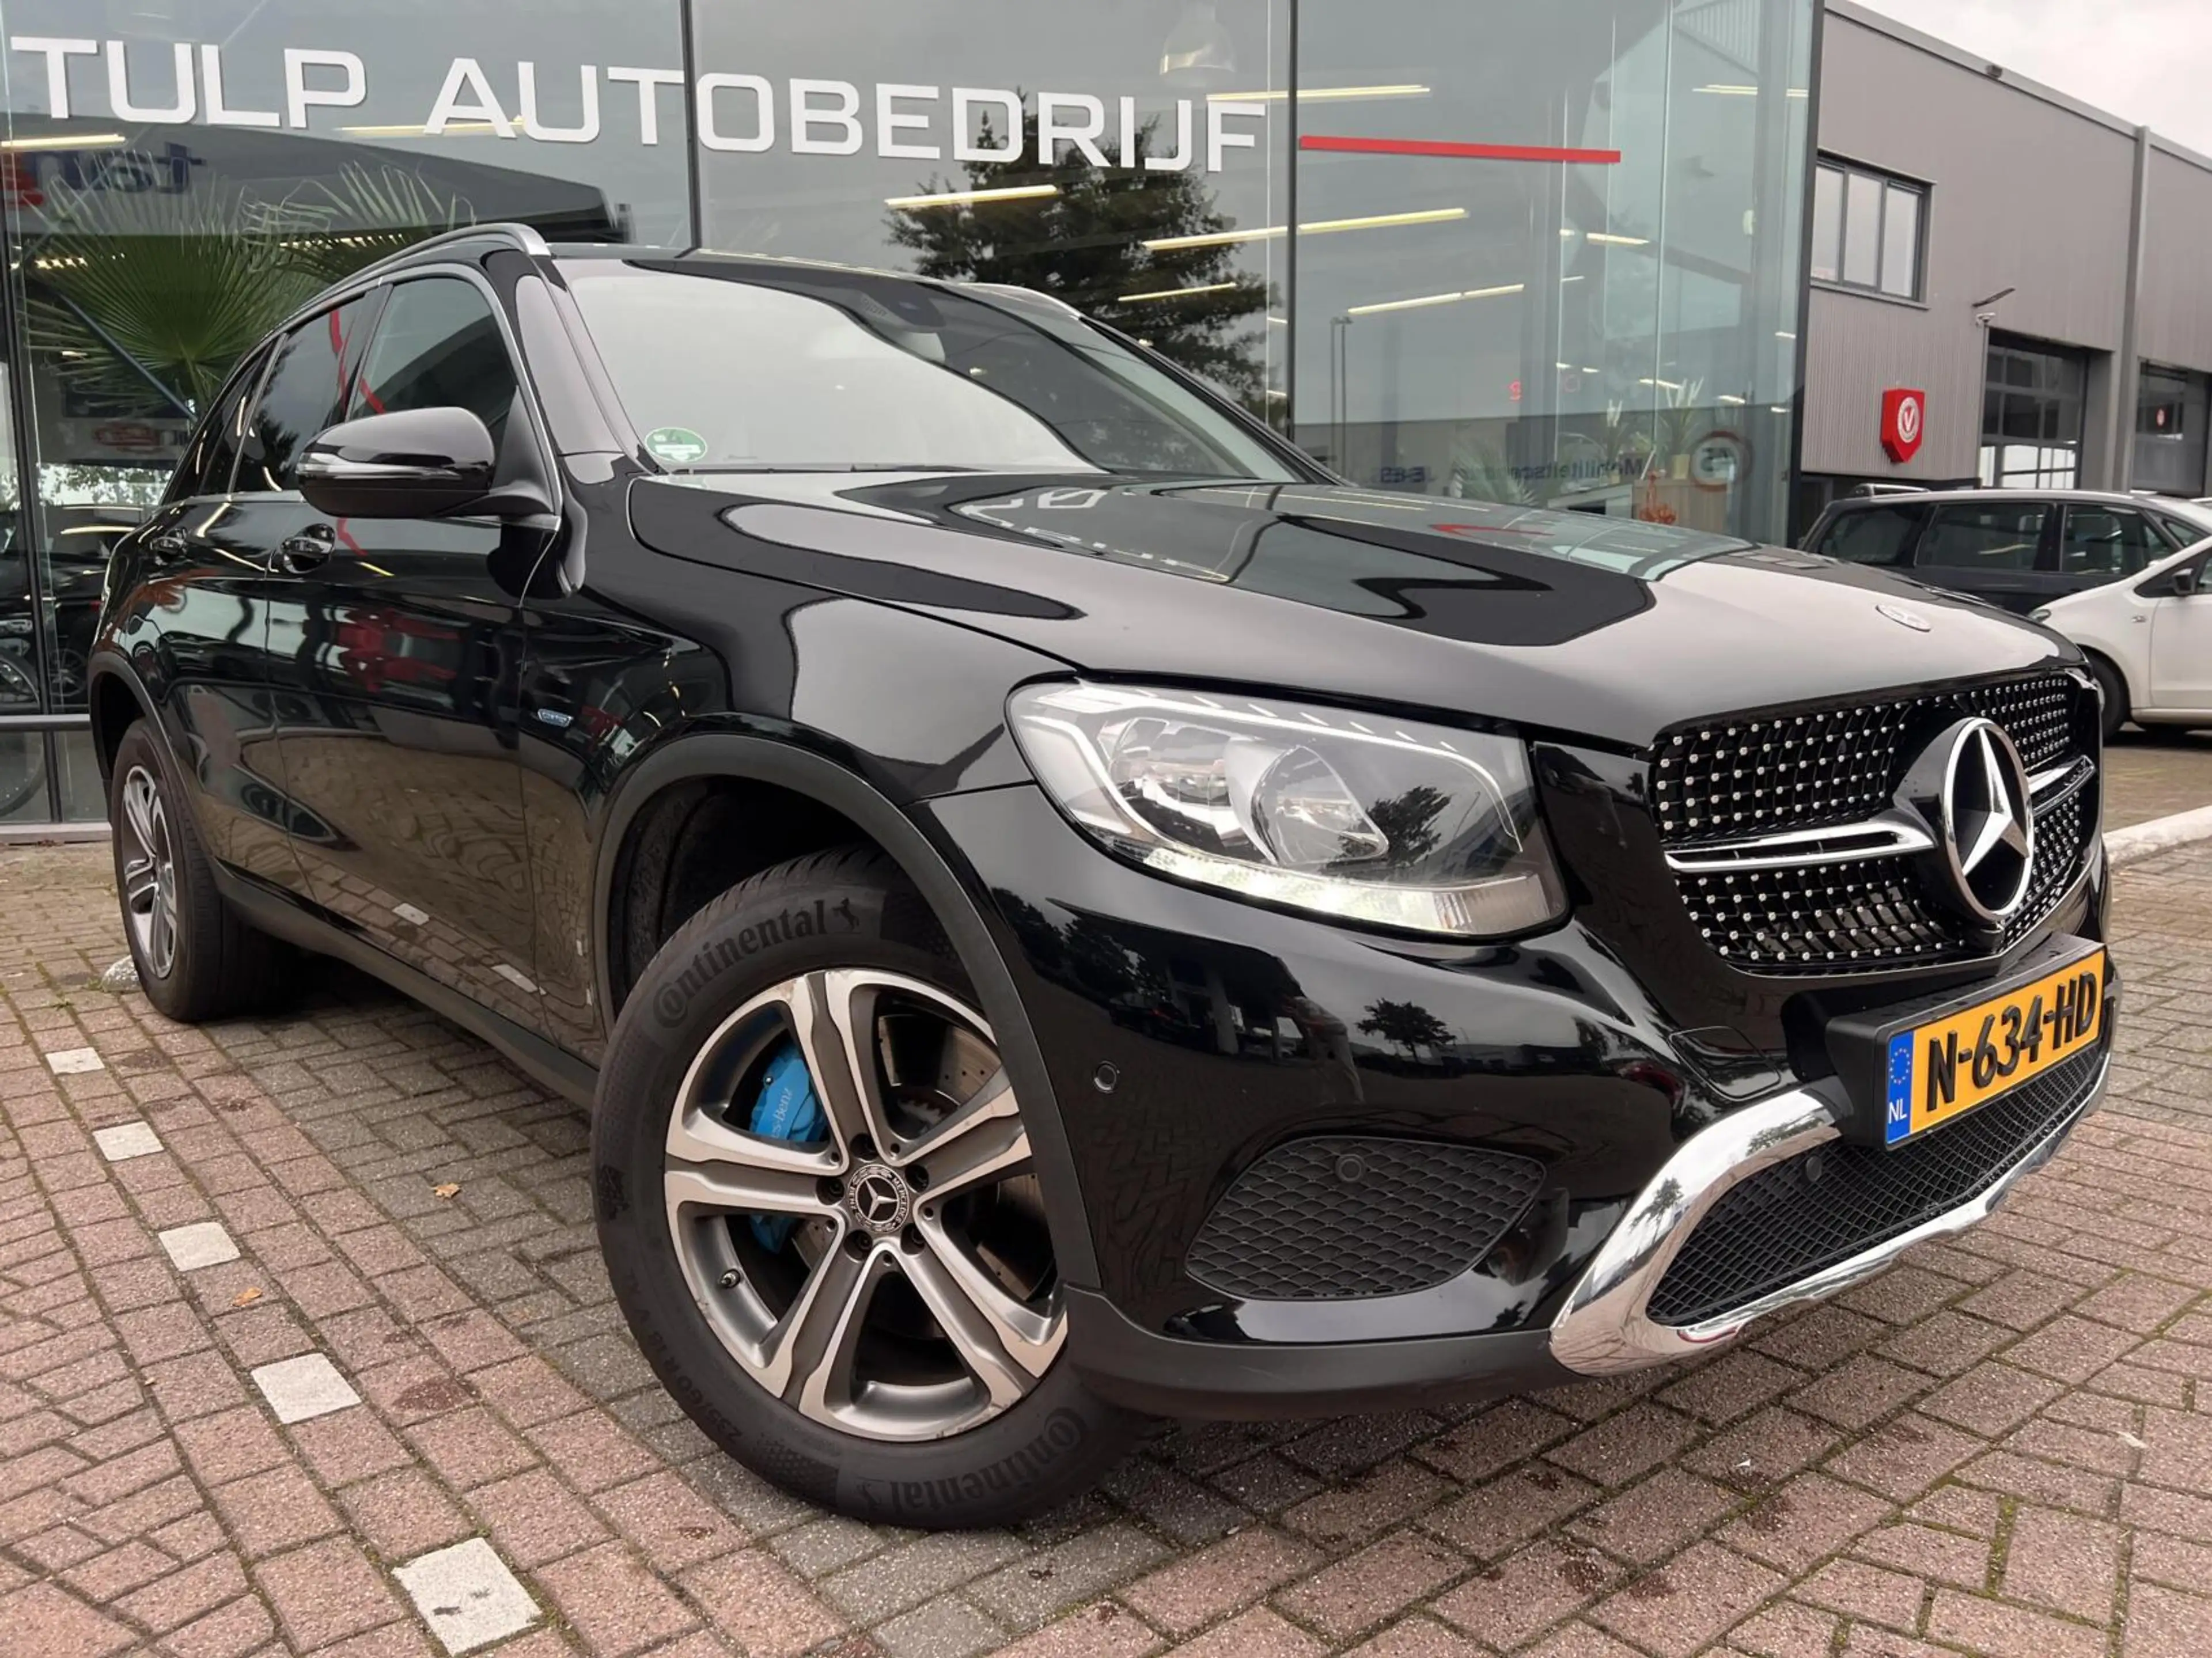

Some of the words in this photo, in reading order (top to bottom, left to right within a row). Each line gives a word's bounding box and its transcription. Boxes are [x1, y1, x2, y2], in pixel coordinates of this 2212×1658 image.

[10, 36, 367, 128] TULP
[423, 57, 1267, 172] AUTOBEDRIJF
[653, 899, 828, 1029] Continental
[1926, 971, 2097, 1113] N-634-HD
[1888, 1098, 1907, 1125] NL
[891, 1405, 1089, 1513] Continental
